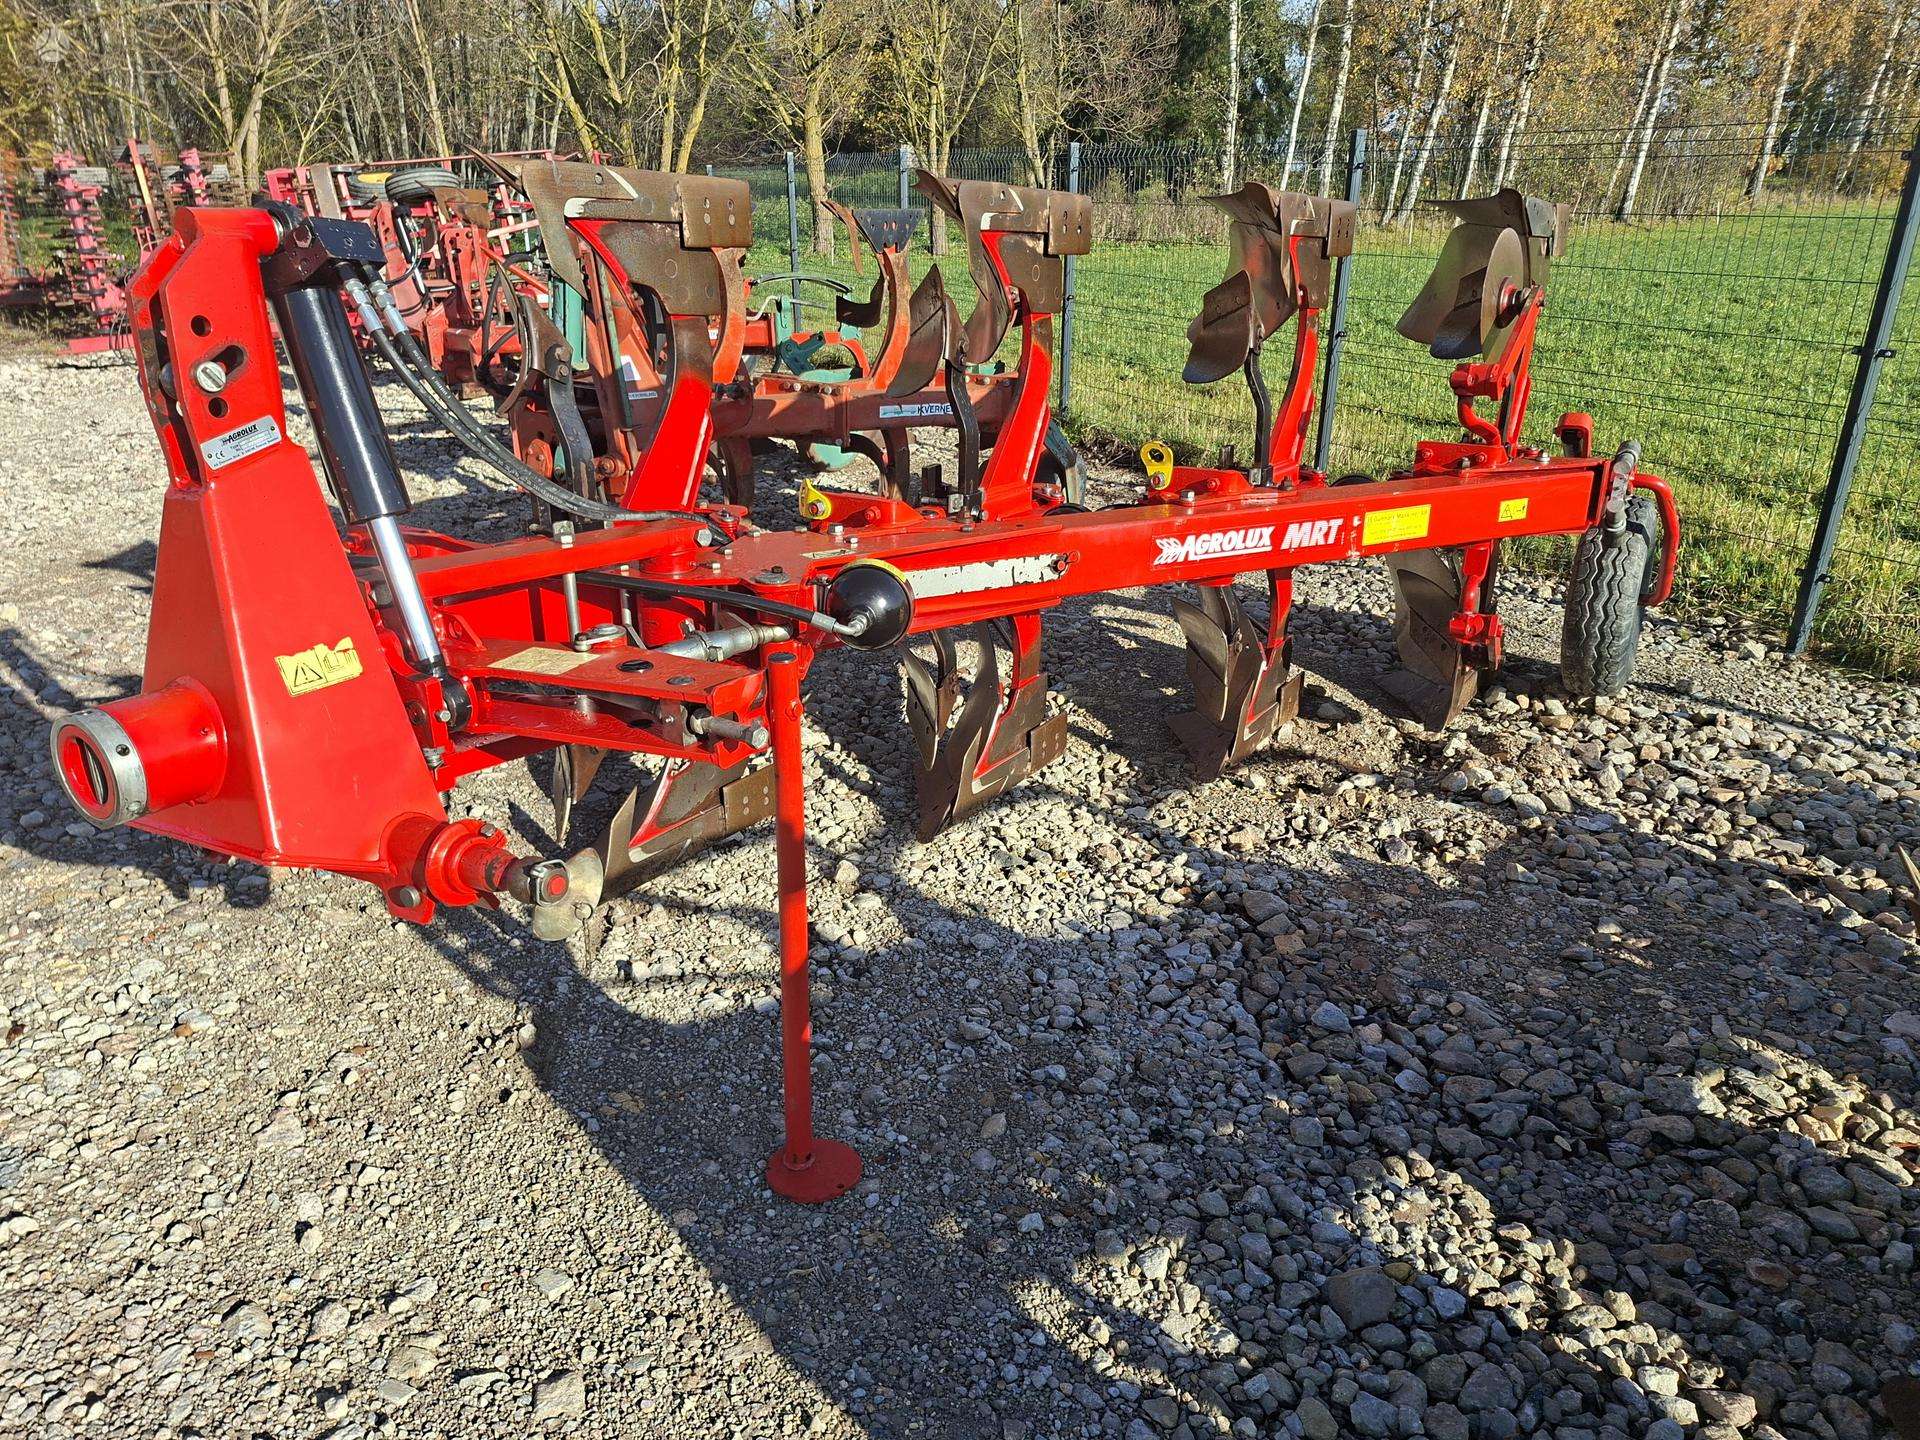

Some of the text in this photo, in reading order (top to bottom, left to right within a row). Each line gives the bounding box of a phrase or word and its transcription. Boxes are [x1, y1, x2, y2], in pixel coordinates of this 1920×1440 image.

[917, 404, 953, 415] KVERNE
[228, 424, 258, 443] AGROLUX
[1179, 526, 1275, 562] AGROLUX
[1280, 518, 1344, 550] MRT
